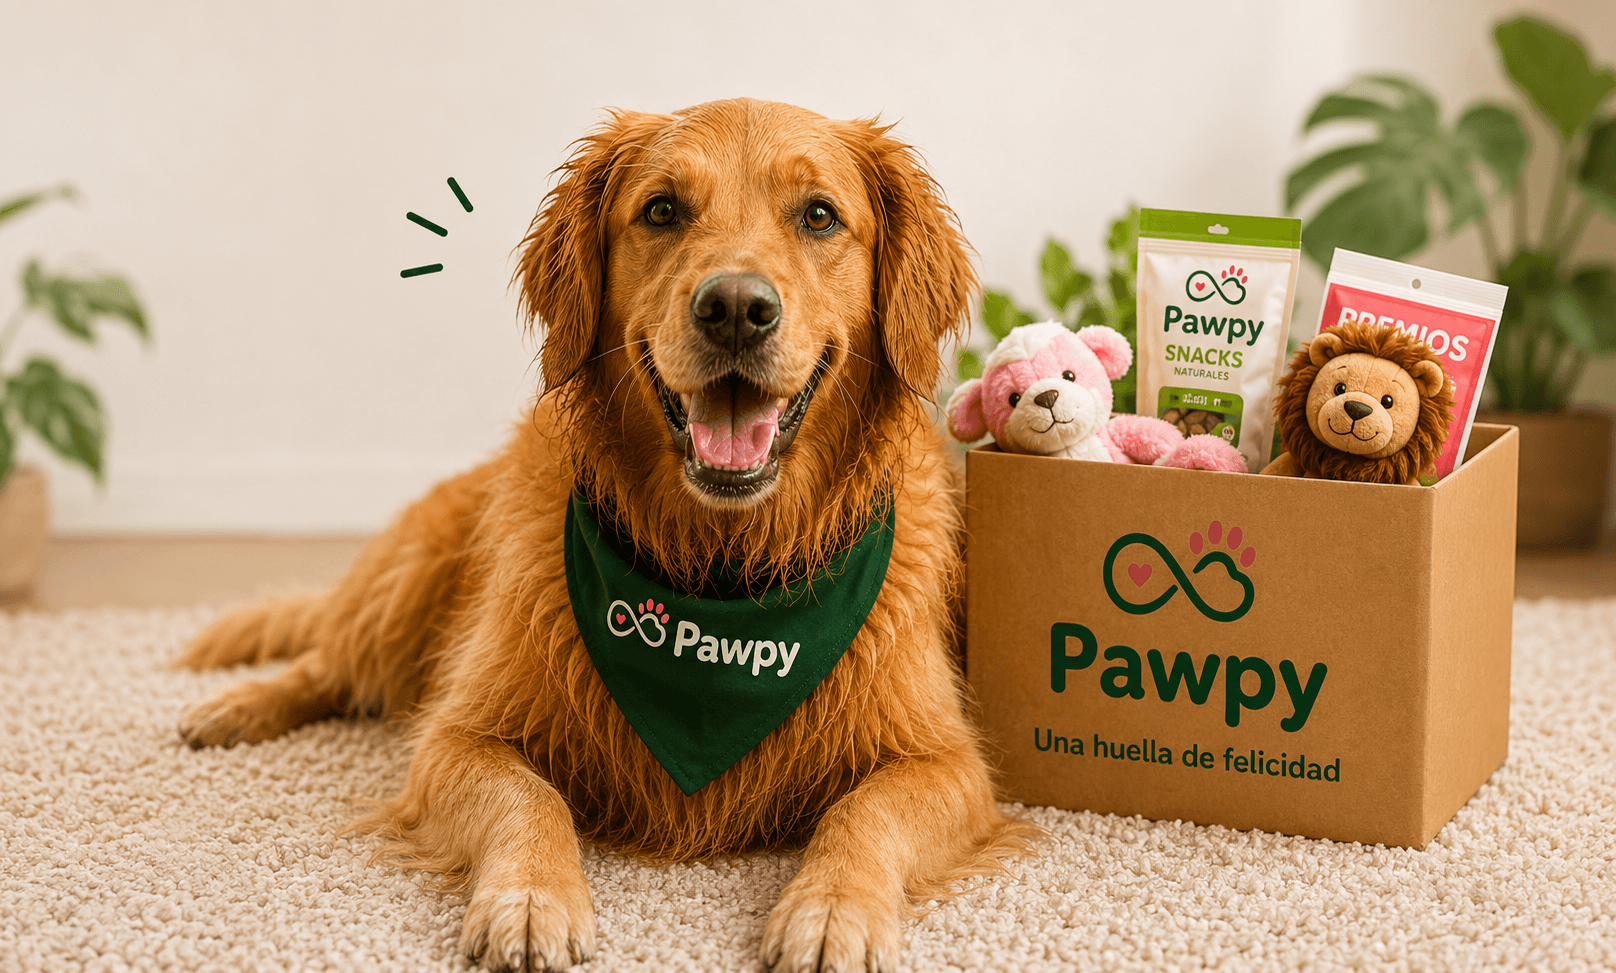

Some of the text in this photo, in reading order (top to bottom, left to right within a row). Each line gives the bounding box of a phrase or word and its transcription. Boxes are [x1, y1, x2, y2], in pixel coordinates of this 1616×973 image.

[1164, 304, 1265, 347] Pawpy
[1164, 344, 1244, 369] SNACKS
[1173, 366, 1230, 381] NATURALES
[673, 620, 801, 678] Pawpy
[1050, 622, 1328, 733] Pawpy
[1034, 727, 1341, 783] Una huella de felicidad
